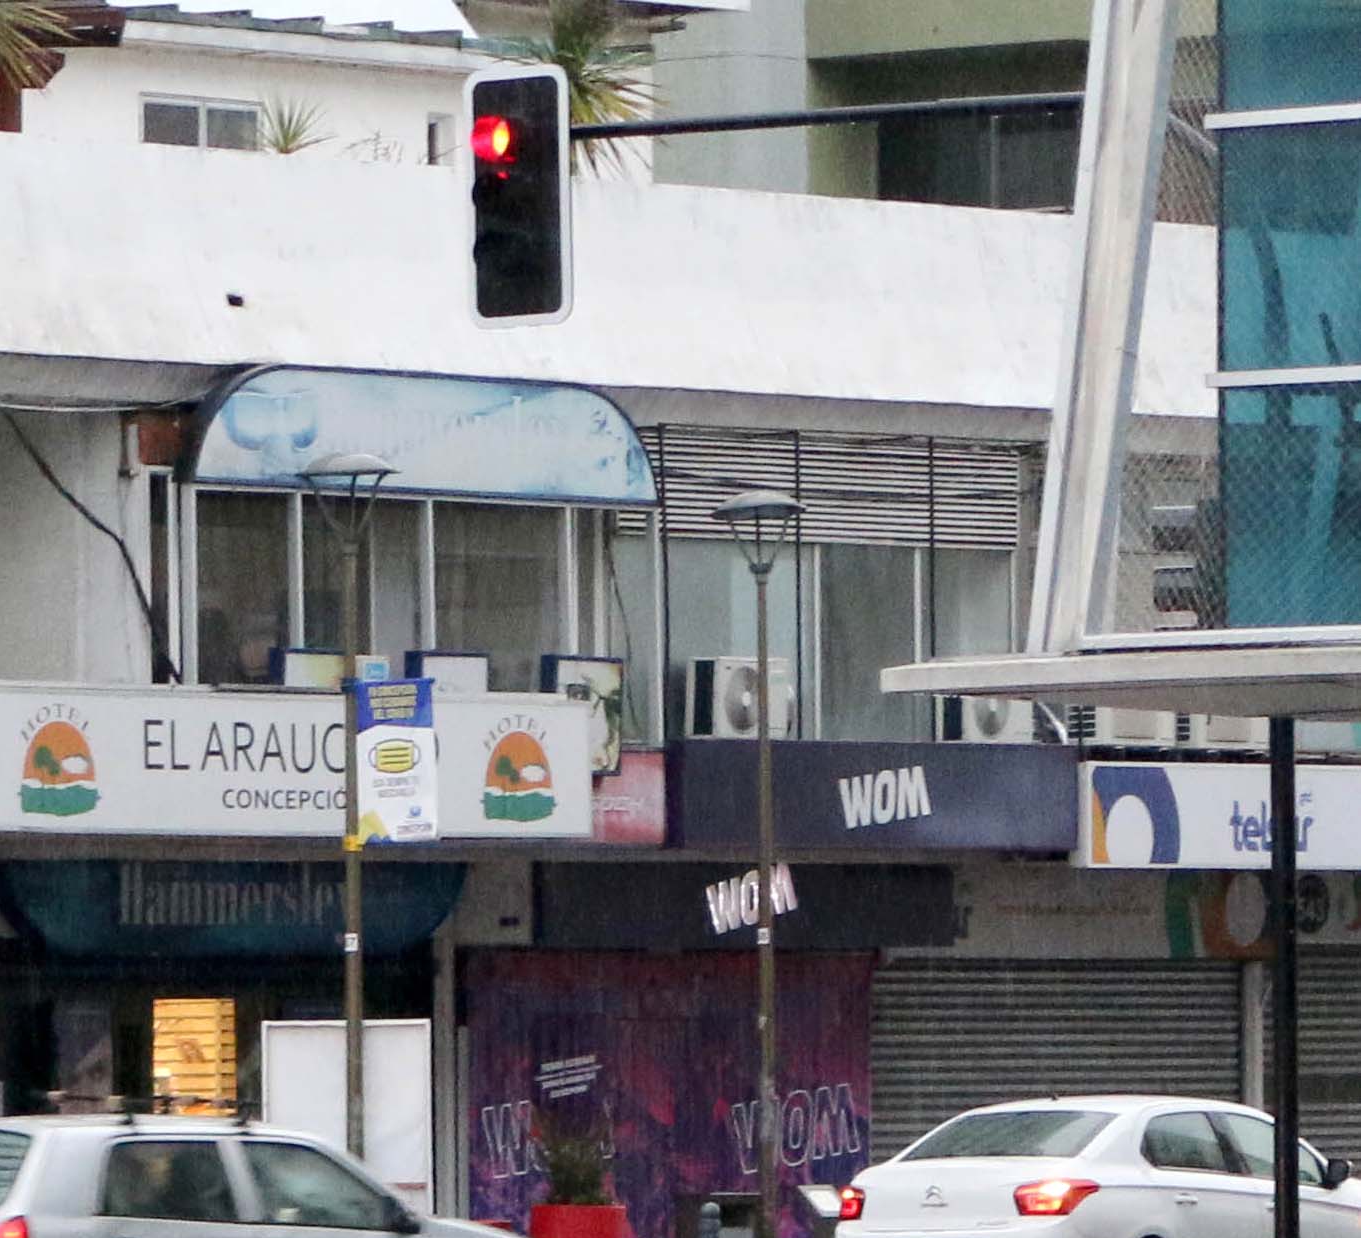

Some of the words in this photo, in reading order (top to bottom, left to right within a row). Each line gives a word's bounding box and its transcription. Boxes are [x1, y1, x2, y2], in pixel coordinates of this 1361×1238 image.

[21, 703, 90, 742] HOTEL
[143, 719, 190, 771] EL
[483, 714, 548, 752] HOTEL
[222, 787, 347, 810] CONCEPCIÓ
[838, 765, 933, 830] WOM
[706, 862, 799, 935] WOM
